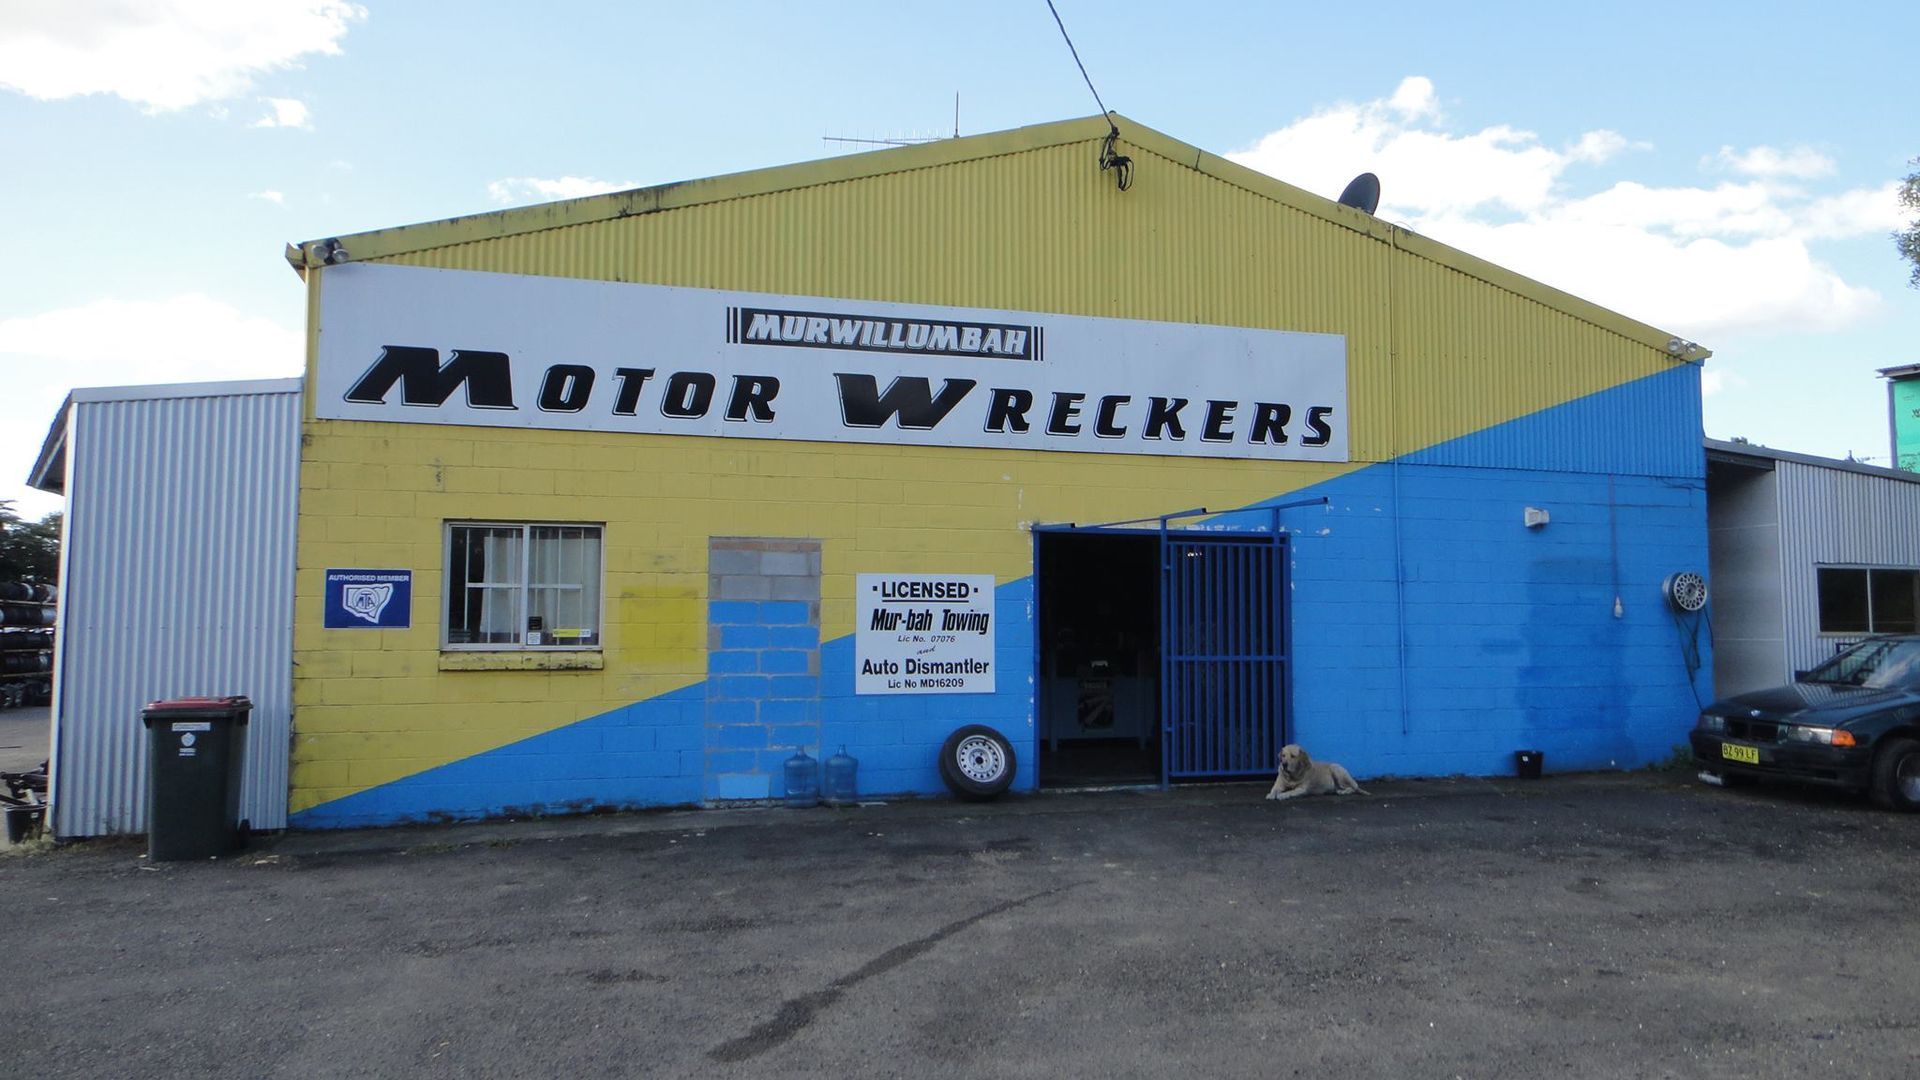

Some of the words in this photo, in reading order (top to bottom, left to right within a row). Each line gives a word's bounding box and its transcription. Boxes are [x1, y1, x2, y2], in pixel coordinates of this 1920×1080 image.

[747, 313, 1026, 355] MURWILLUMBAH
[343, 345, 780, 423] MOTOR
[833, 372, 1333, 447] WRECKERS
[881, 581, 970, 598] LICENSED
[870, 608, 933, 631] Mur-bah
[941, 609, 990, 635] Towing
[898, 635, 910, 643] Lic
[912, 635, 926, 643] No.
[930, 635, 956, 643] 07076
[862, 658, 899, 675] Auto
[905, 658, 989, 675] Dismantler
[888, 679, 901, 689] Lic
[904, 679, 917, 689] No
[920, 678, 964, 687] MD16209
